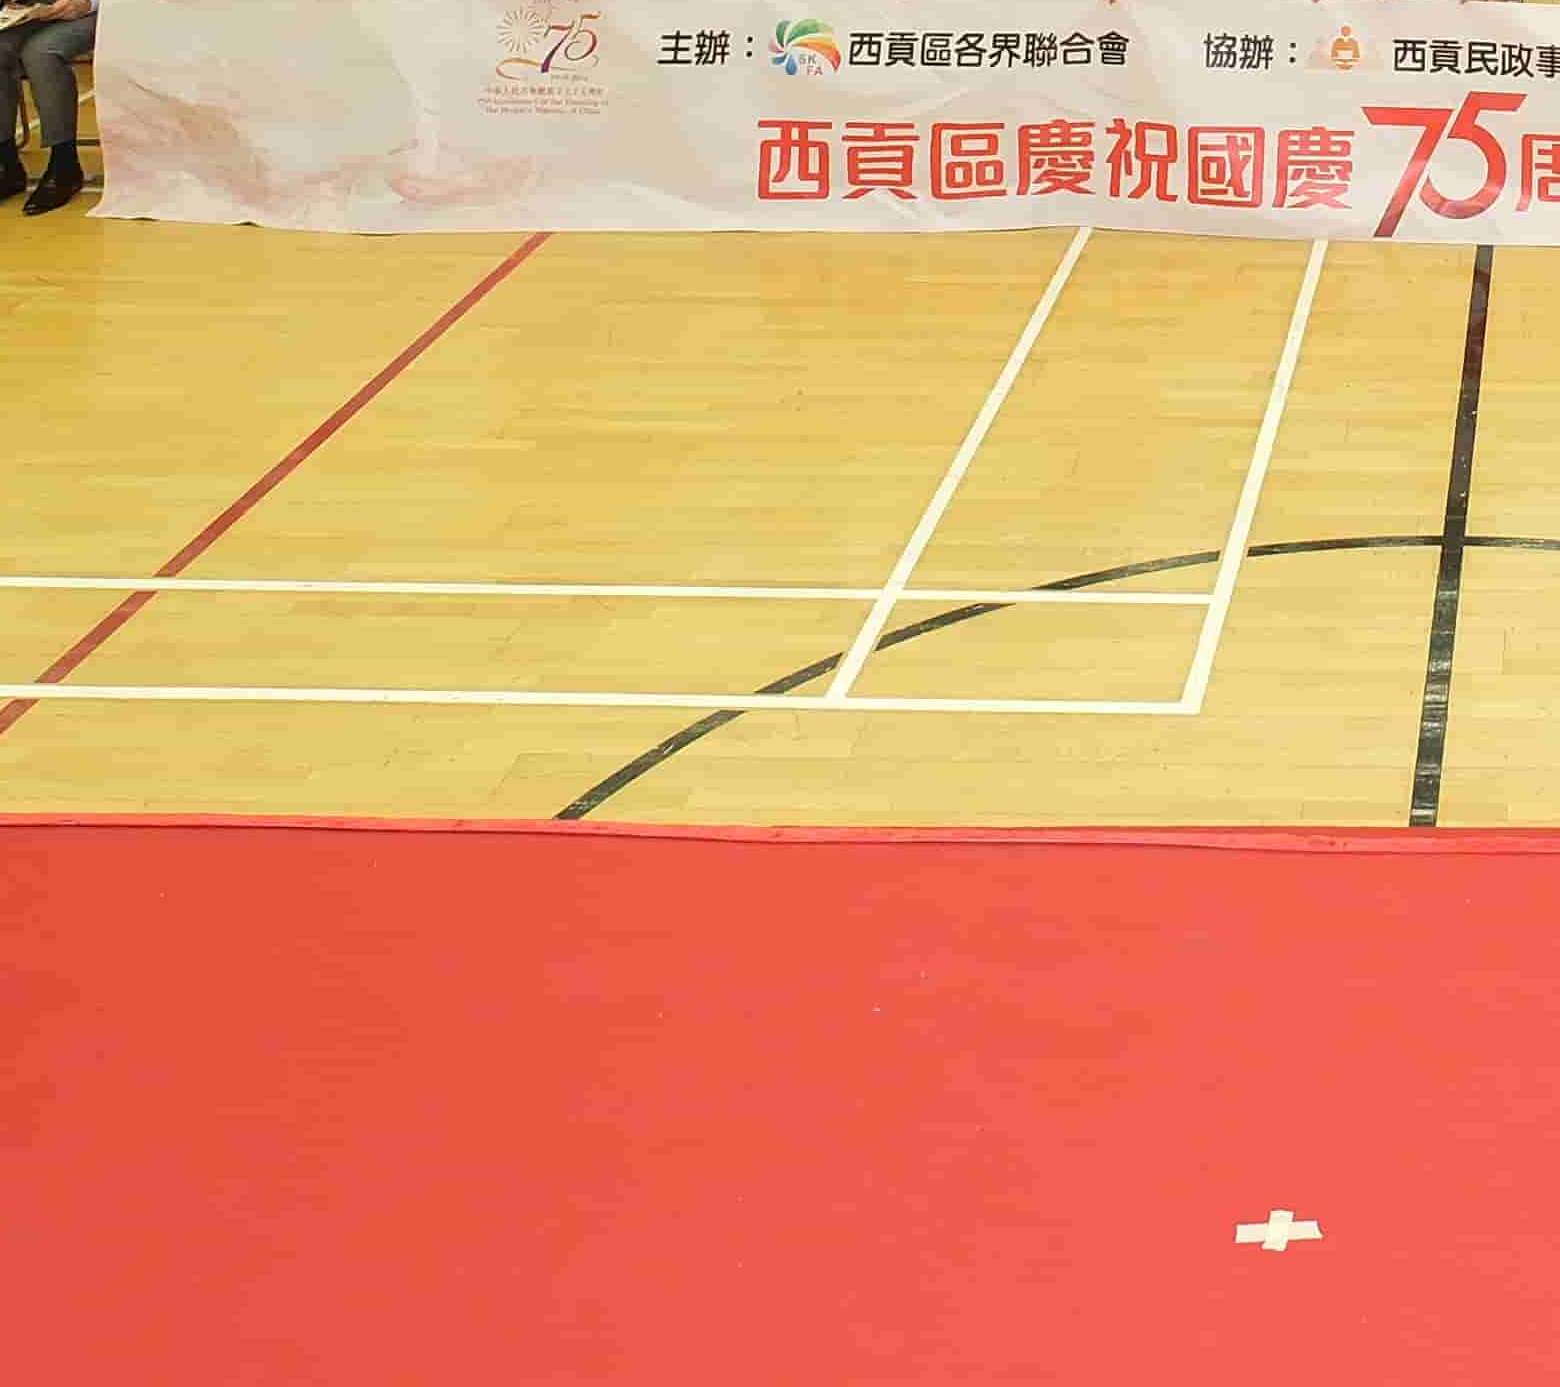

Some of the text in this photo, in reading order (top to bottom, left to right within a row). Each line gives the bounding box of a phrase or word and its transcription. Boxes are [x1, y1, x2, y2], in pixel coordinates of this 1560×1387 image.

[848, 31, 1130, 69] 西貢區各界聯合會
